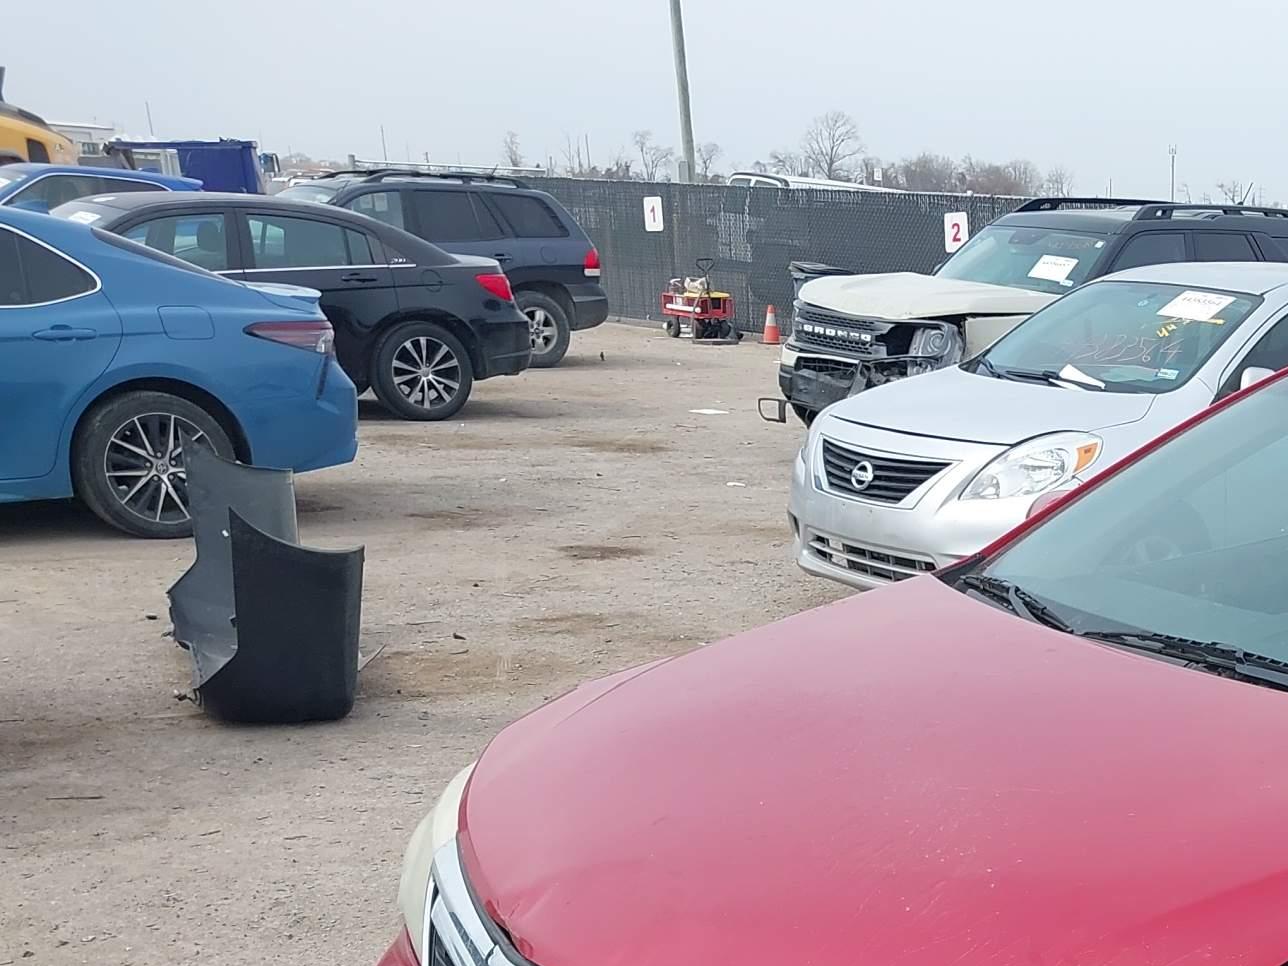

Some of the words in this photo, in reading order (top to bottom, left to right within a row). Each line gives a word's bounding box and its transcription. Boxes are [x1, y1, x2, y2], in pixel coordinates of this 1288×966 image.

[650, 204, 656, 223] 1
[951, 222, 962, 242] 2
[803, 324, 872, 341] BRONCO
